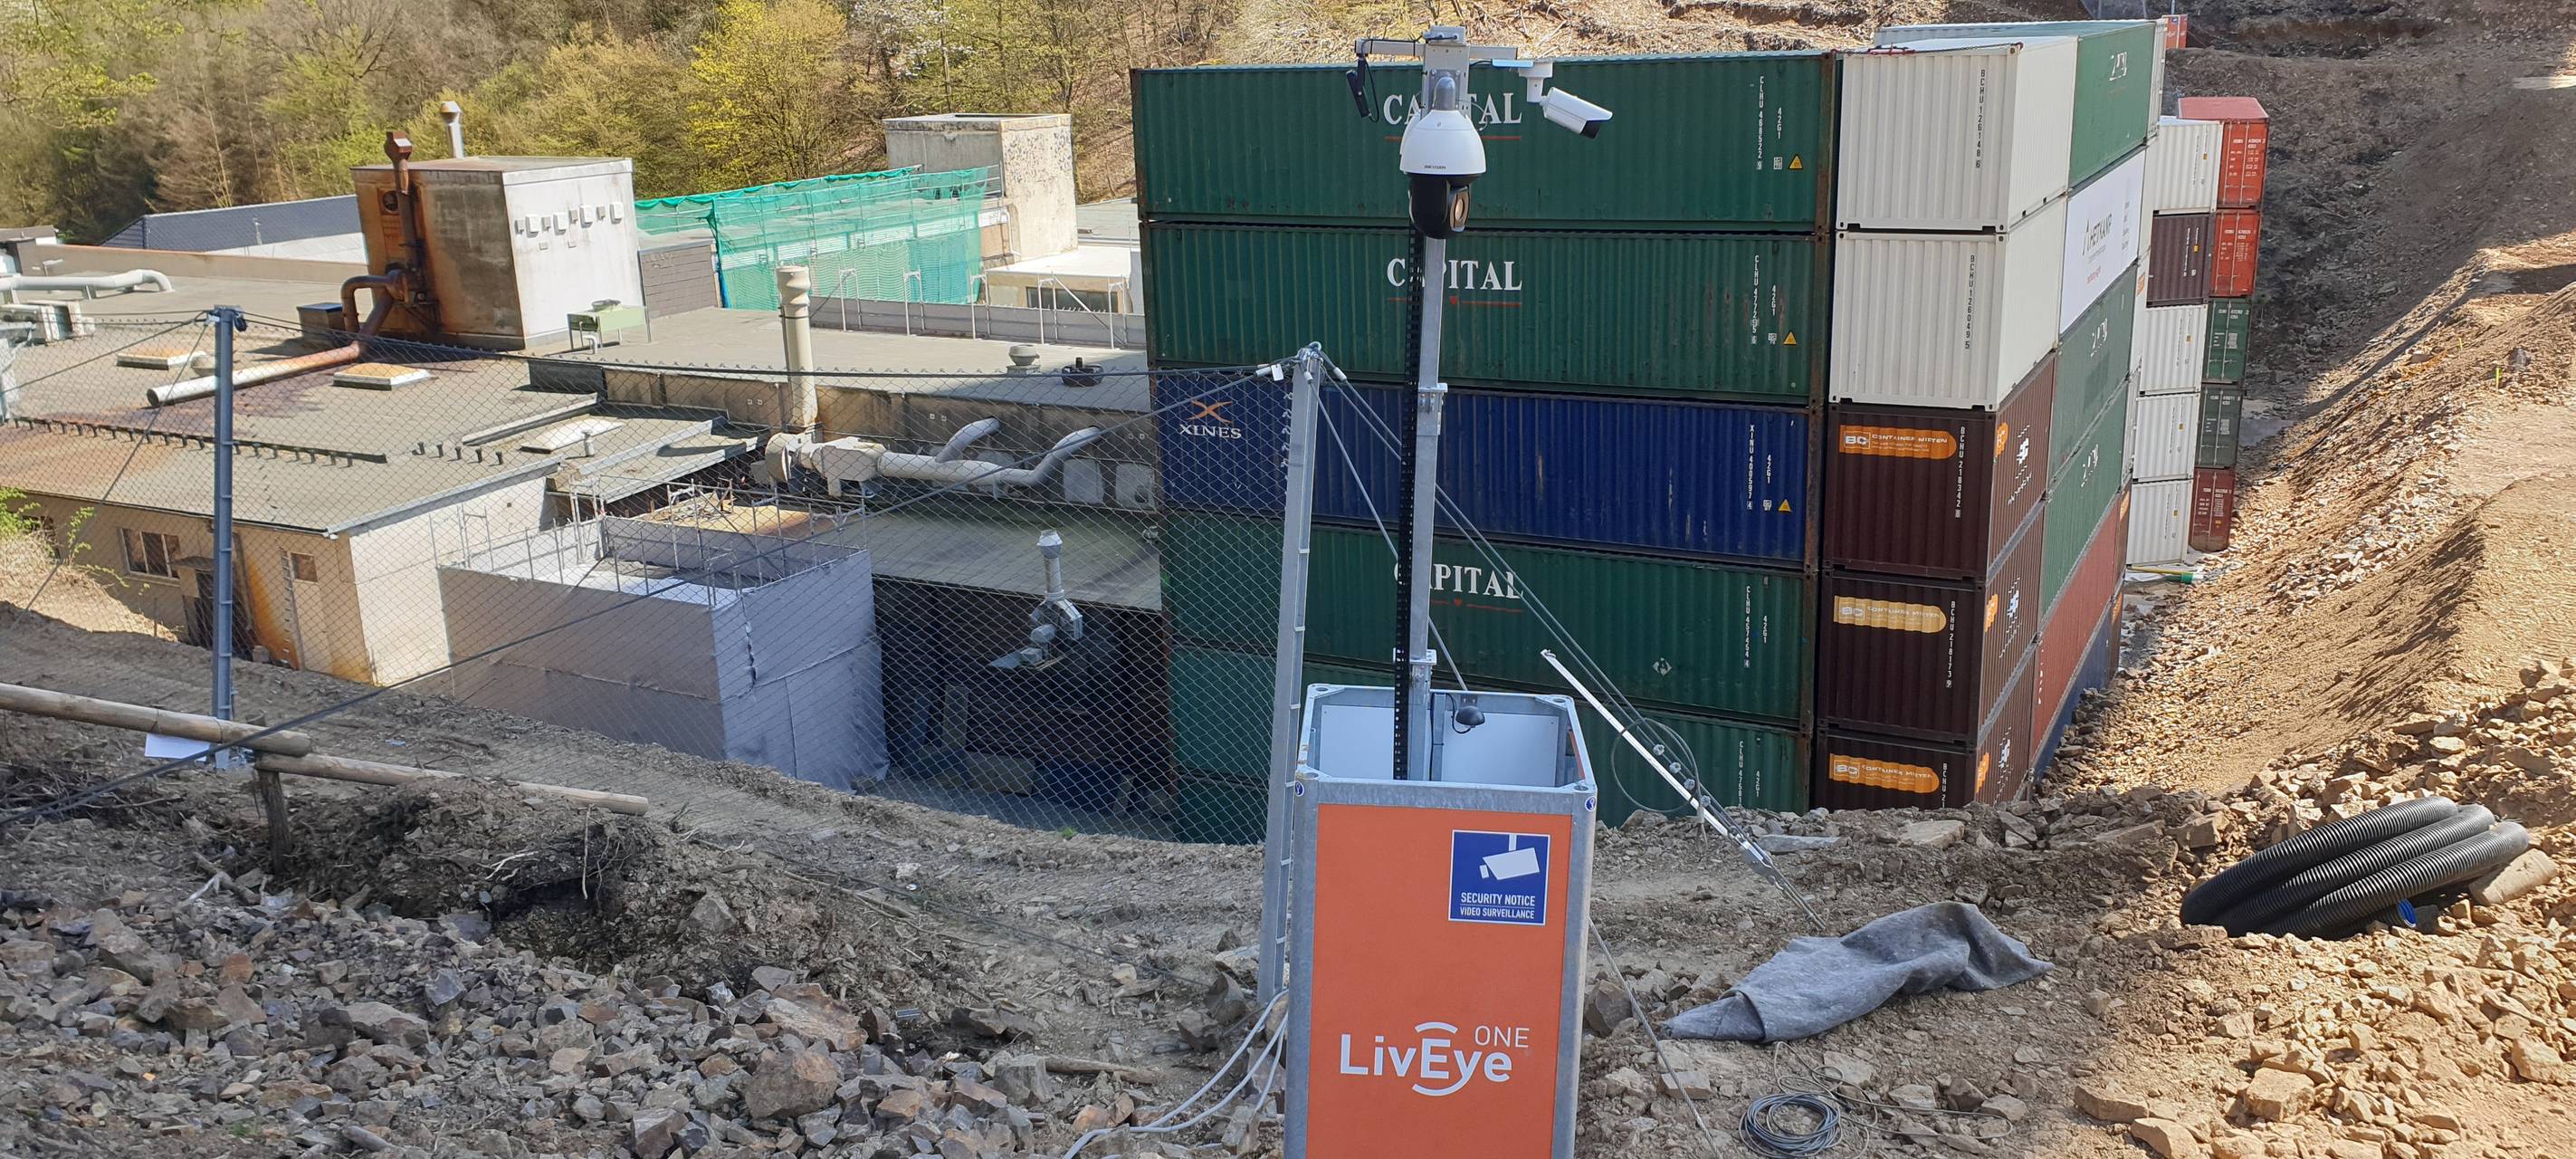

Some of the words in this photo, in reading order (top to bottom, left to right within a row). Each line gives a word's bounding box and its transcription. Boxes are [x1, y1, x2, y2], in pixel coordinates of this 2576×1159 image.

[1383, 92, 1522, 125] CAAL
[1387, 258, 1522, 291] CITAL
[1179, 424, 1243, 439] XINES
[1460, 892, 1503, 905] SECURITY
[1504, 894, 1536, 906] NOTICE
[1459, 905, 1481, 916] VIDEO
[1482, 907, 1535, 919] SURVEILLANCE
[1340, 1032, 1512, 1097] LivEye
[1474, 1025, 1530, 1048] ONE
